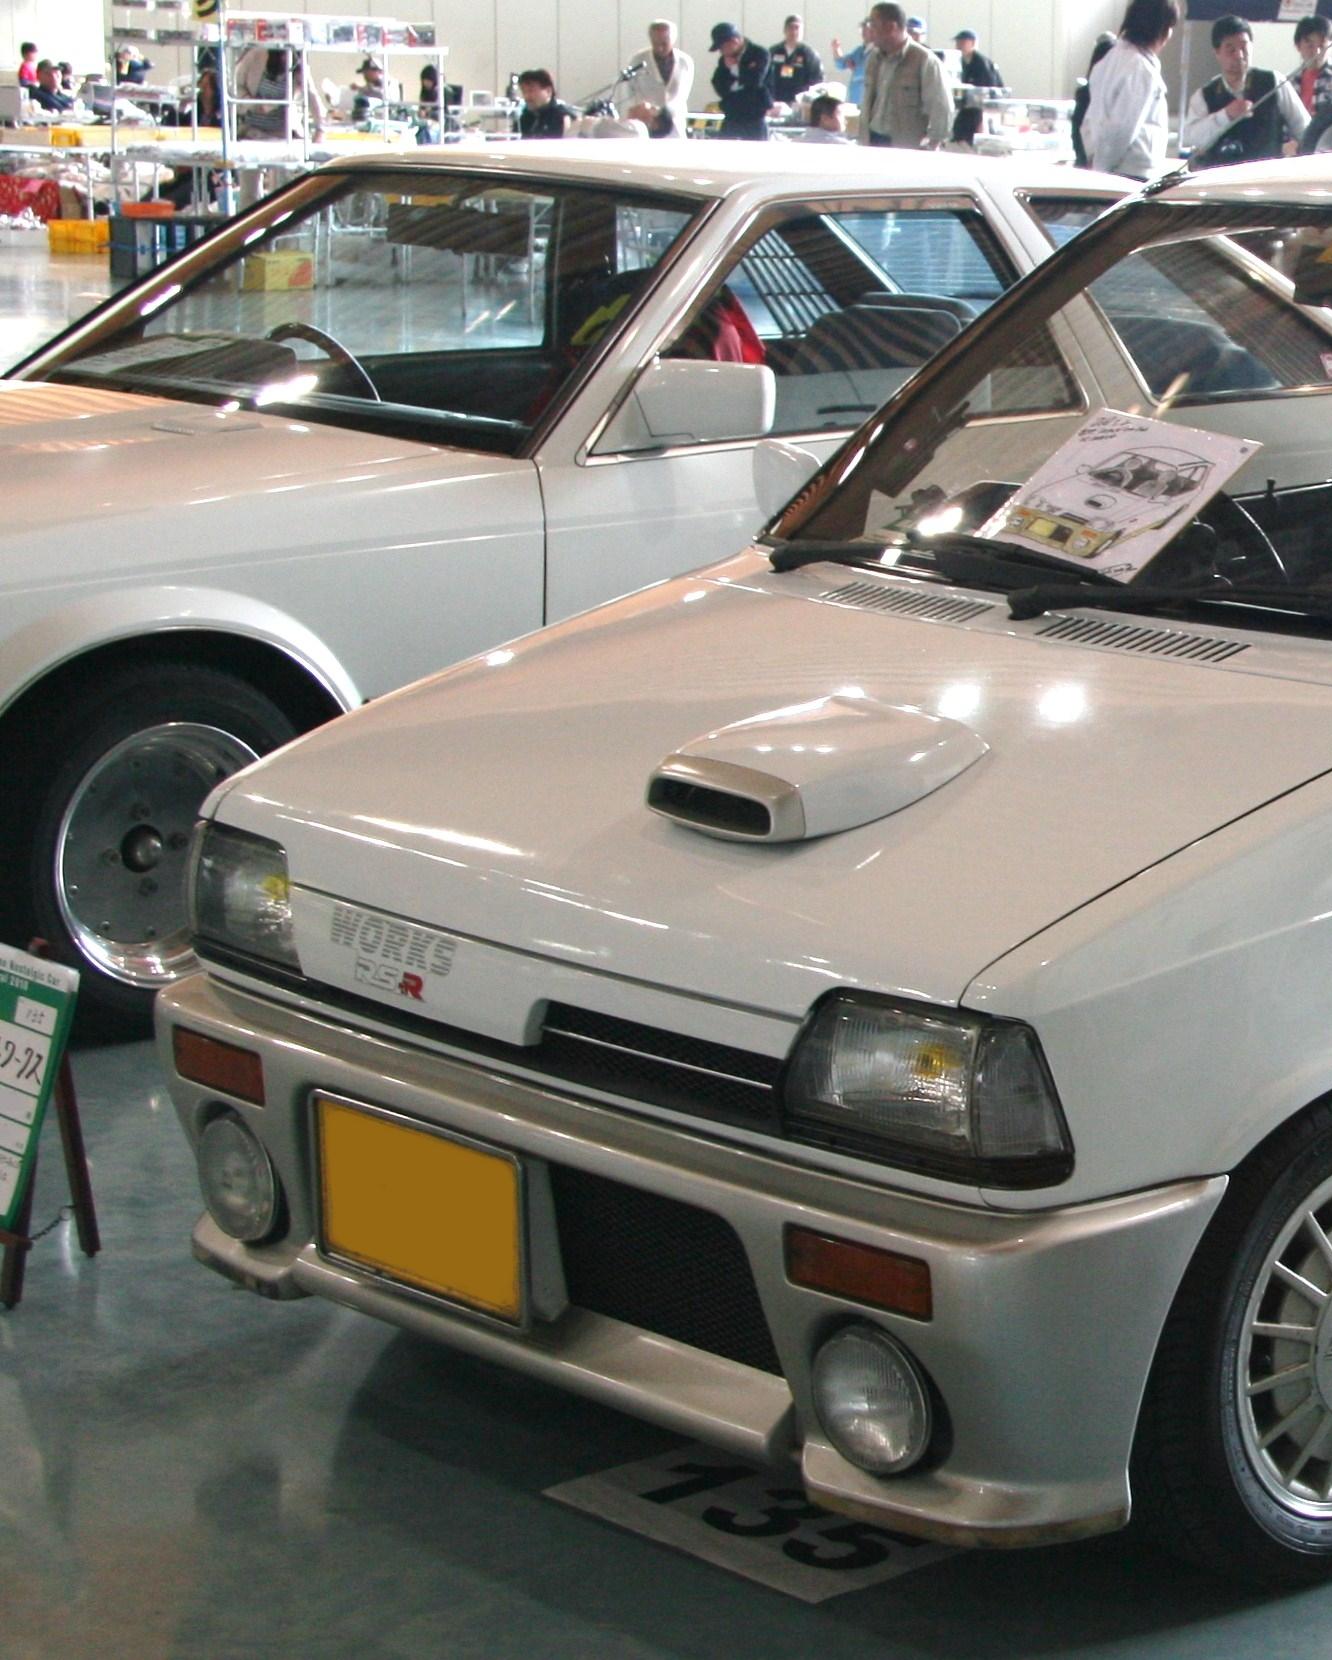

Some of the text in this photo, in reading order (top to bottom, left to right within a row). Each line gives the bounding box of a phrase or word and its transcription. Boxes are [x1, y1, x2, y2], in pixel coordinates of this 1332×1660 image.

[330, 904, 458, 977] WORKS
[47, 973, 62, 986] Car
[0, 1039, 44, 1086] ワークス
[637, 1462, 933, 1571] 135
